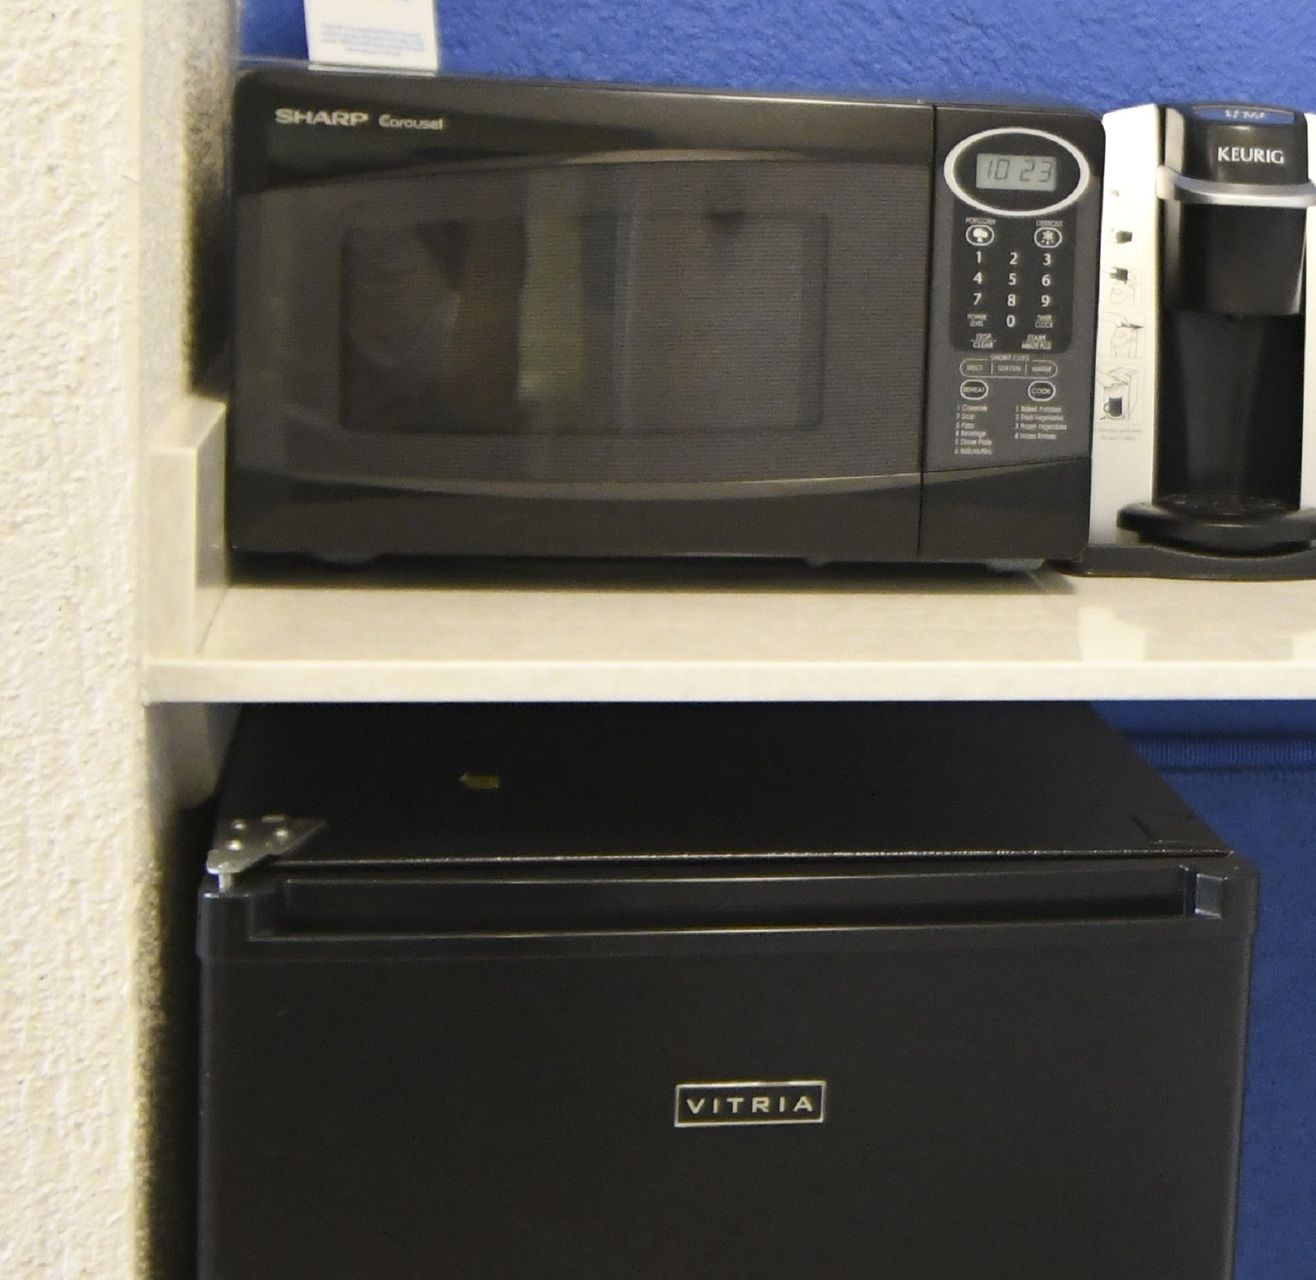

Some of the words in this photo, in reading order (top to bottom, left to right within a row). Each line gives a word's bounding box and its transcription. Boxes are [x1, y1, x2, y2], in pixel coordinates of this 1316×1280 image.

[275, 108, 369, 126] SHARP
[378, 114, 444, 130] Carousel
[1217, 147, 1284, 164] KEURIG
[976, 251, 982, 264] 1
[1009, 252, 1018, 265] 2
[1042, 253, 1052, 266] 3
[973, 272, 983, 284] 4
[1008, 273, 1017, 286] 5
[1041, 274, 1051, 287] 6
[973, 292, 982, 306] 7
[1007, 294, 1016, 307] 8
[1041, 295, 1050, 307] 9
[1006, 315, 1016, 327] 0
[686, 1096, 813, 1114] VITRIA
